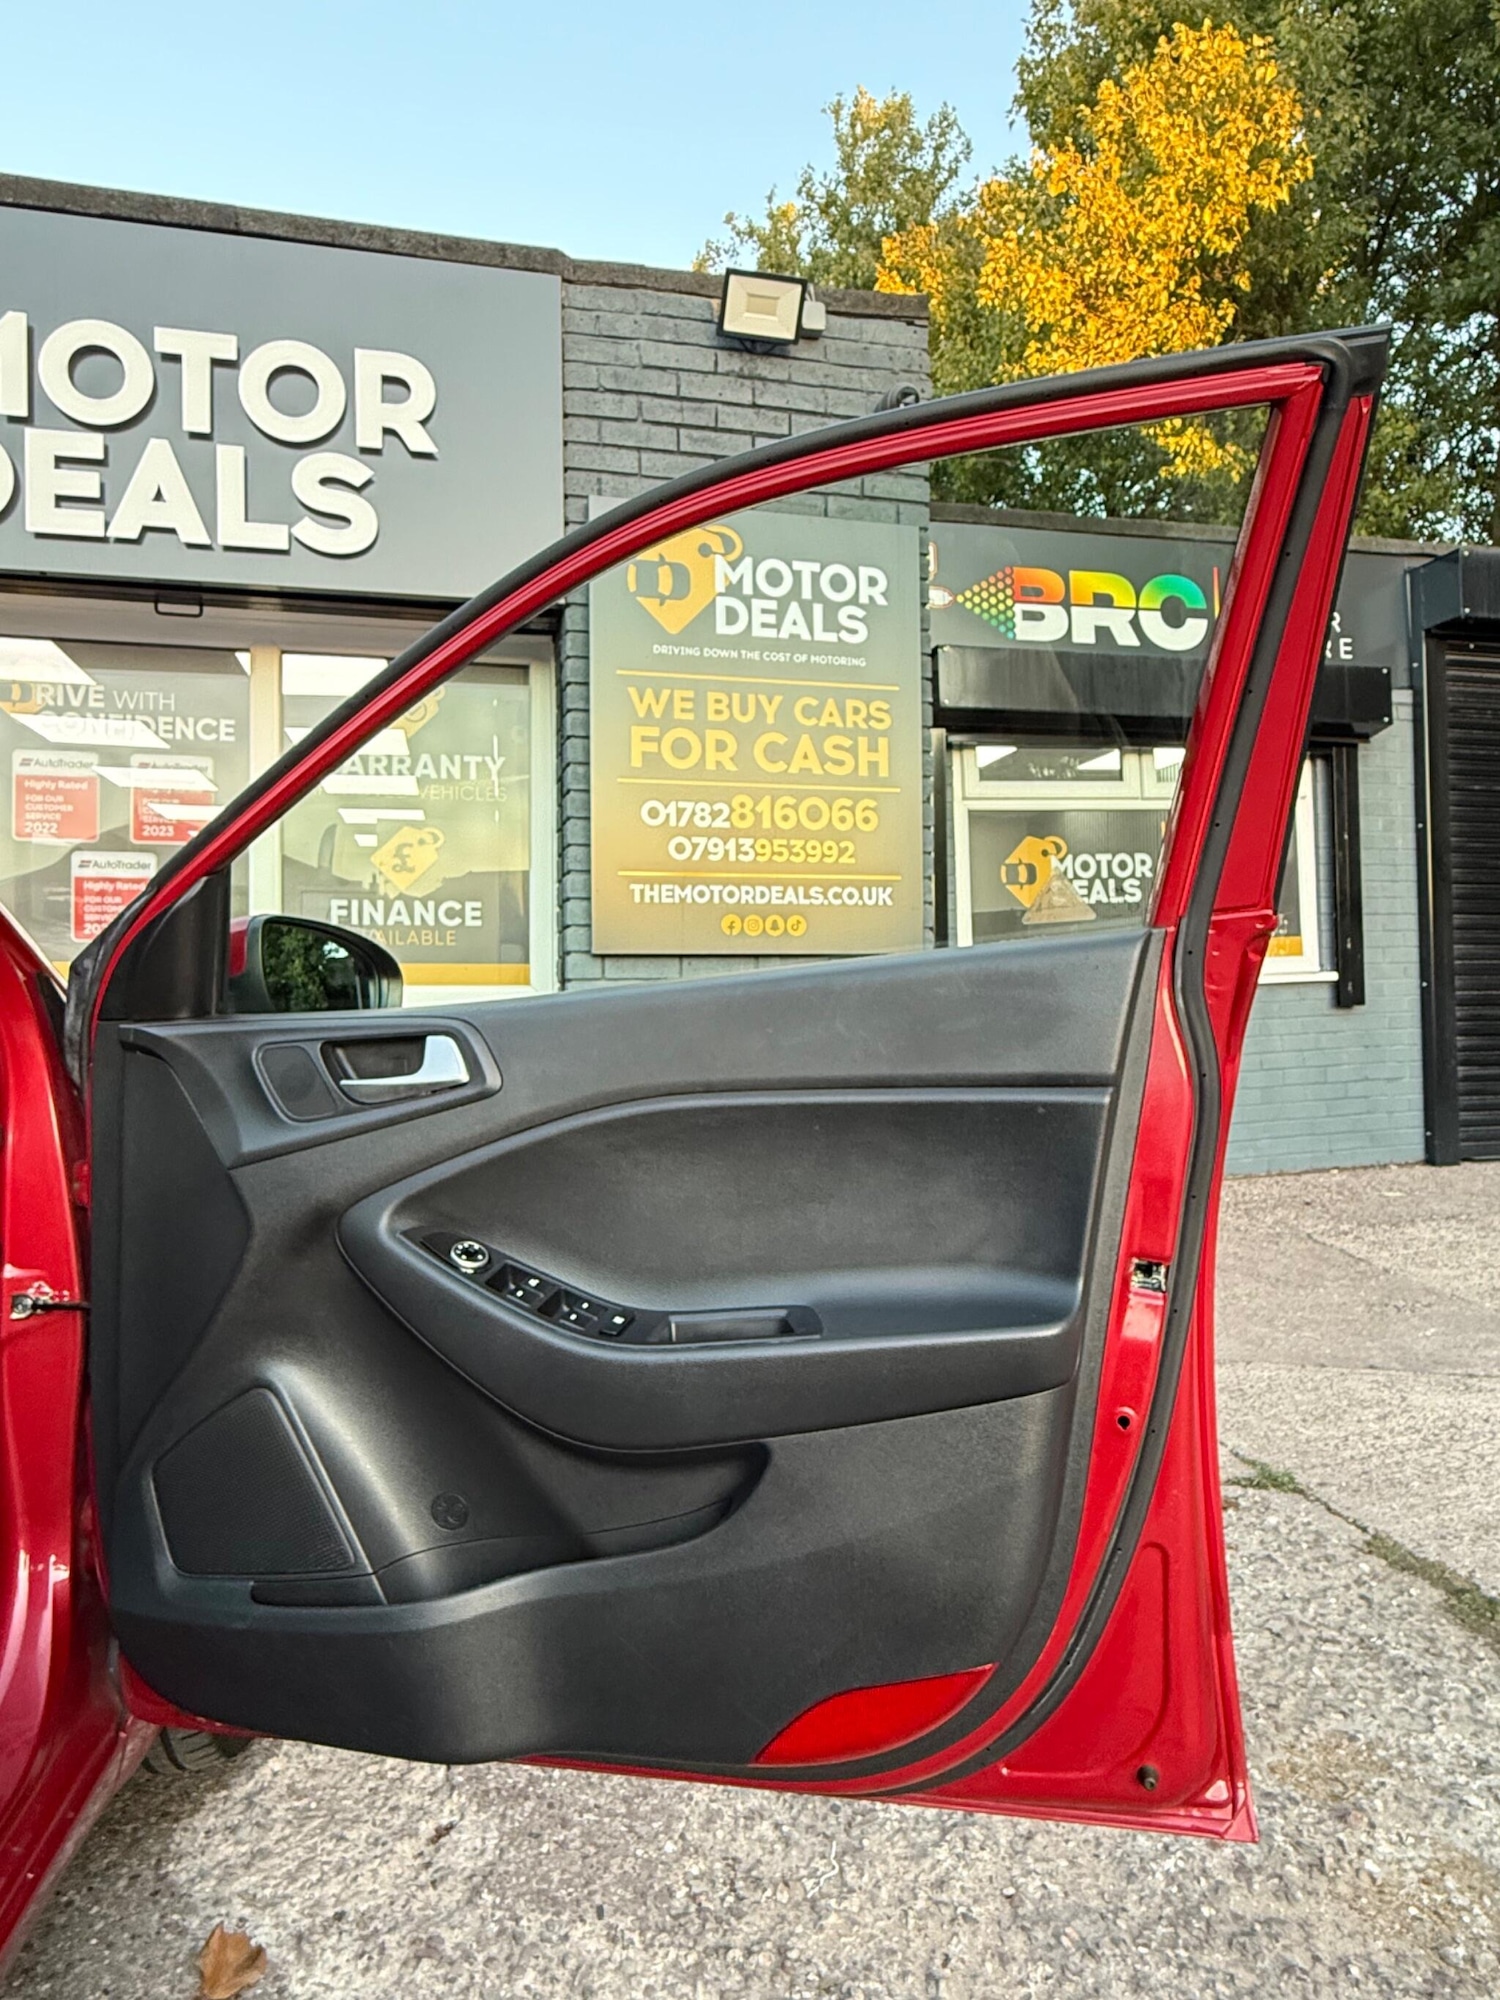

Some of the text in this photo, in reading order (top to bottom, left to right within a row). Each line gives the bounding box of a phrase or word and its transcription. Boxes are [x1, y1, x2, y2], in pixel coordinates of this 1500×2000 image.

[0, 311, 438, 454] OTOR
[0, 427, 378, 556] EALS
[714, 554, 888, 605] MOTOR
[716, 596, 869, 644] DEALS
[1012, 566, 1209, 651] BRC
[652, 644, 867, 667] DRIVING DOWN THE COST OF MOTORING
[113, 690, 175, 711] WITH
[627, 686, 892, 730] WE BUY CARS
[34, 758, 94, 769] AutoTrader
[630, 725, 890, 777] FOR CASH
[342, 753, 506, 781] ARRANTY
[419, 784, 508, 802] VEHICLES
[24, 821, 58, 834] 2022
[141, 824, 175, 837] 2023
[668, 836, 856, 864] 07913953992
[92, 859, 152, 870] AutoTrader
[1051, 852, 1153, 879] MOTOR
[629, 883, 893, 906] THEMOTORDEALS.CO.UK
[1072, 878, 1142, 904] EALS
[330, 899, 483, 927] FINANCE
